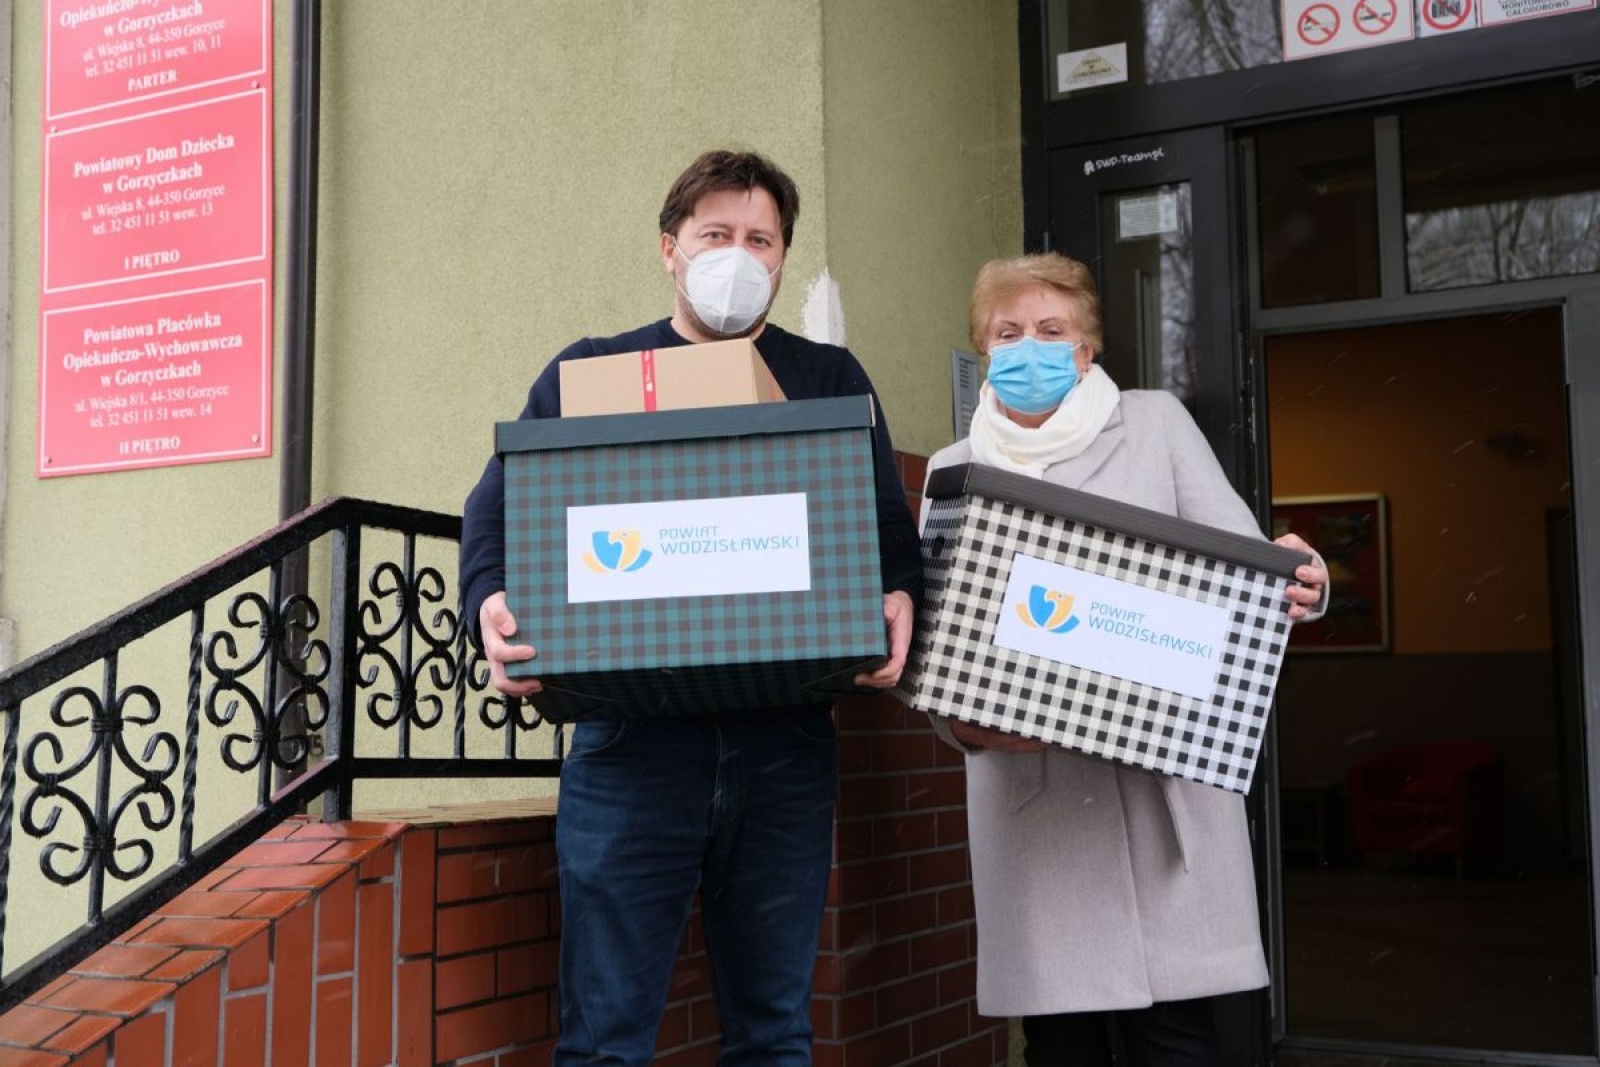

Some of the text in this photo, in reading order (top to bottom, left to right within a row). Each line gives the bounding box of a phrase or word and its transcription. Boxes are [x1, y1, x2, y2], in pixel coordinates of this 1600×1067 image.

[104, 3, 203, 37] w Gorzyczkach
[98, 40, 134, 58] Wiejska
[148, 27, 182, 44] 44-350
[183, 19, 225, 36] Gorzyce
[85, 64, 99, 77] tel.
[103, 61, 114, 73] 32
[116, 57, 133, 70] 451
[137, 53, 147, 64] 11
[150, 50, 161, 62] 51
[165, 46, 188, 59] wew.
[211, 36, 222, 49] 11
[128, 69, 177, 92] PARTER
[74, 133, 234, 178] Powiatowy Dom Dziecka
[102, 162, 203, 195] w Gorzyczkach
[80, 208, 93, 221] ul.
[96, 200, 134, 218] Wiejska
[147, 192, 182, 208] 44-350
[183, 185, 225, 202] Gorzyce
[92, 203, 214, 235] tel. 32 451 11 51 wew. 13
[124, 249, 180, 271] I PIĘTRO
[83, 311, 221, 345] Powiatowa Placówka
[63, 333, 243, 372] Opiekuńczo-Wychowawcza
[100, 360, 202, 388] w Gorzyczkach
[75, 400, 87, 413] ul.
[90, 394, 128, 413] Wiejska
[150, 387, 185, 403] 44-350
[186, 384, 229, 400] Gorzyce
[90, 403, 212, 428] tel. 32 451 11 51 wew. 14
[119, 436, 181, 455] II PIĘTRO
[659, 525, 720, 540] POWIAT
[660, 535, 800, 556] WODZISŁAWSKI
[1090, 600, 1147, 625] POWIAT
[1088, 614, 1213, 660] WODZISŁAWSKI
